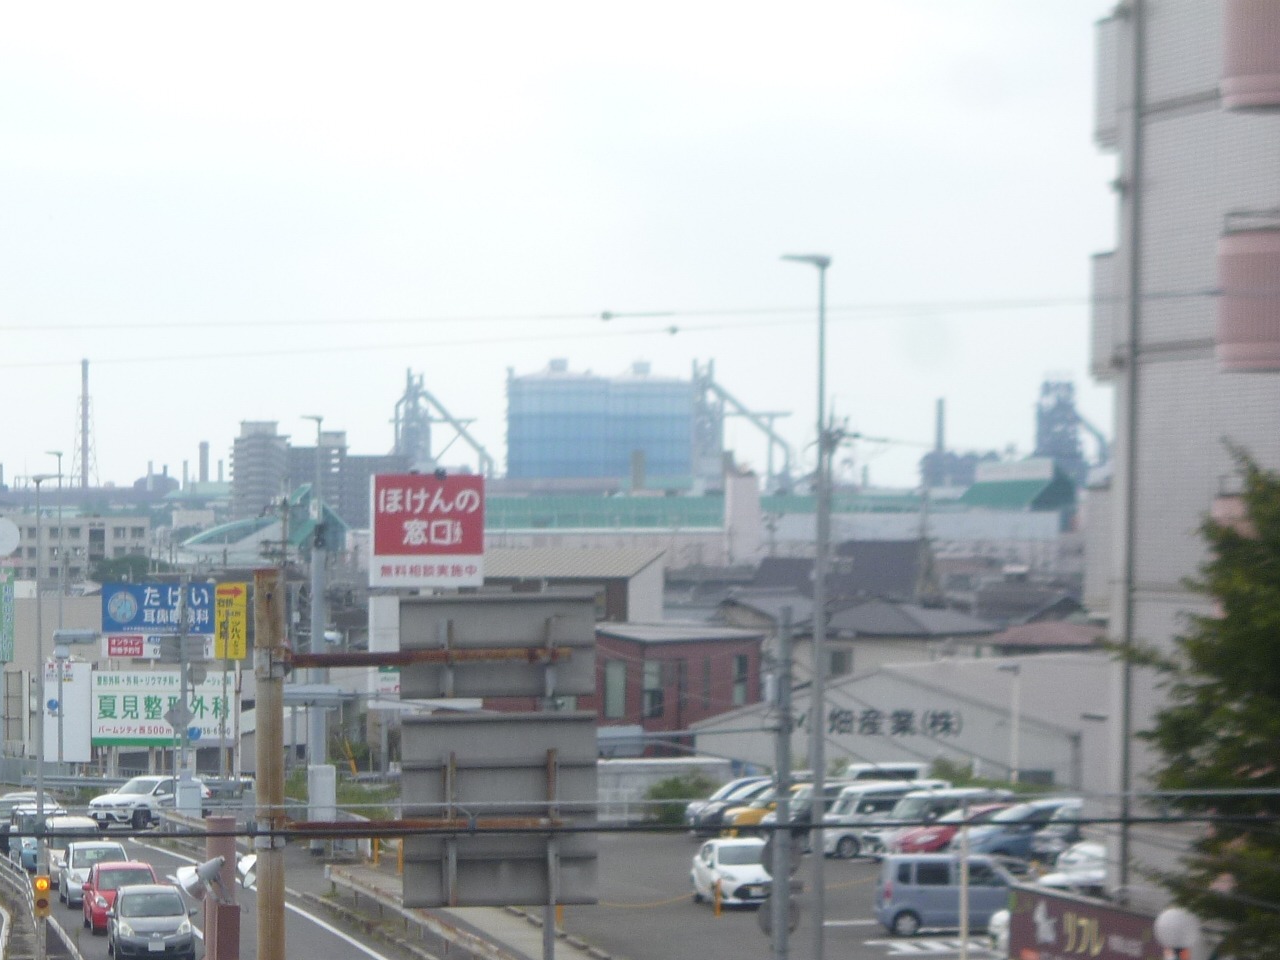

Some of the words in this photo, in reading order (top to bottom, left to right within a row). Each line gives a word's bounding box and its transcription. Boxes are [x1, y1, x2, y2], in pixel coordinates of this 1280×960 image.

[380, 487, 480, 514] ほけんの
[402, 519, 451, 545] 窓口
[143, 587, 209, 606] たけい
